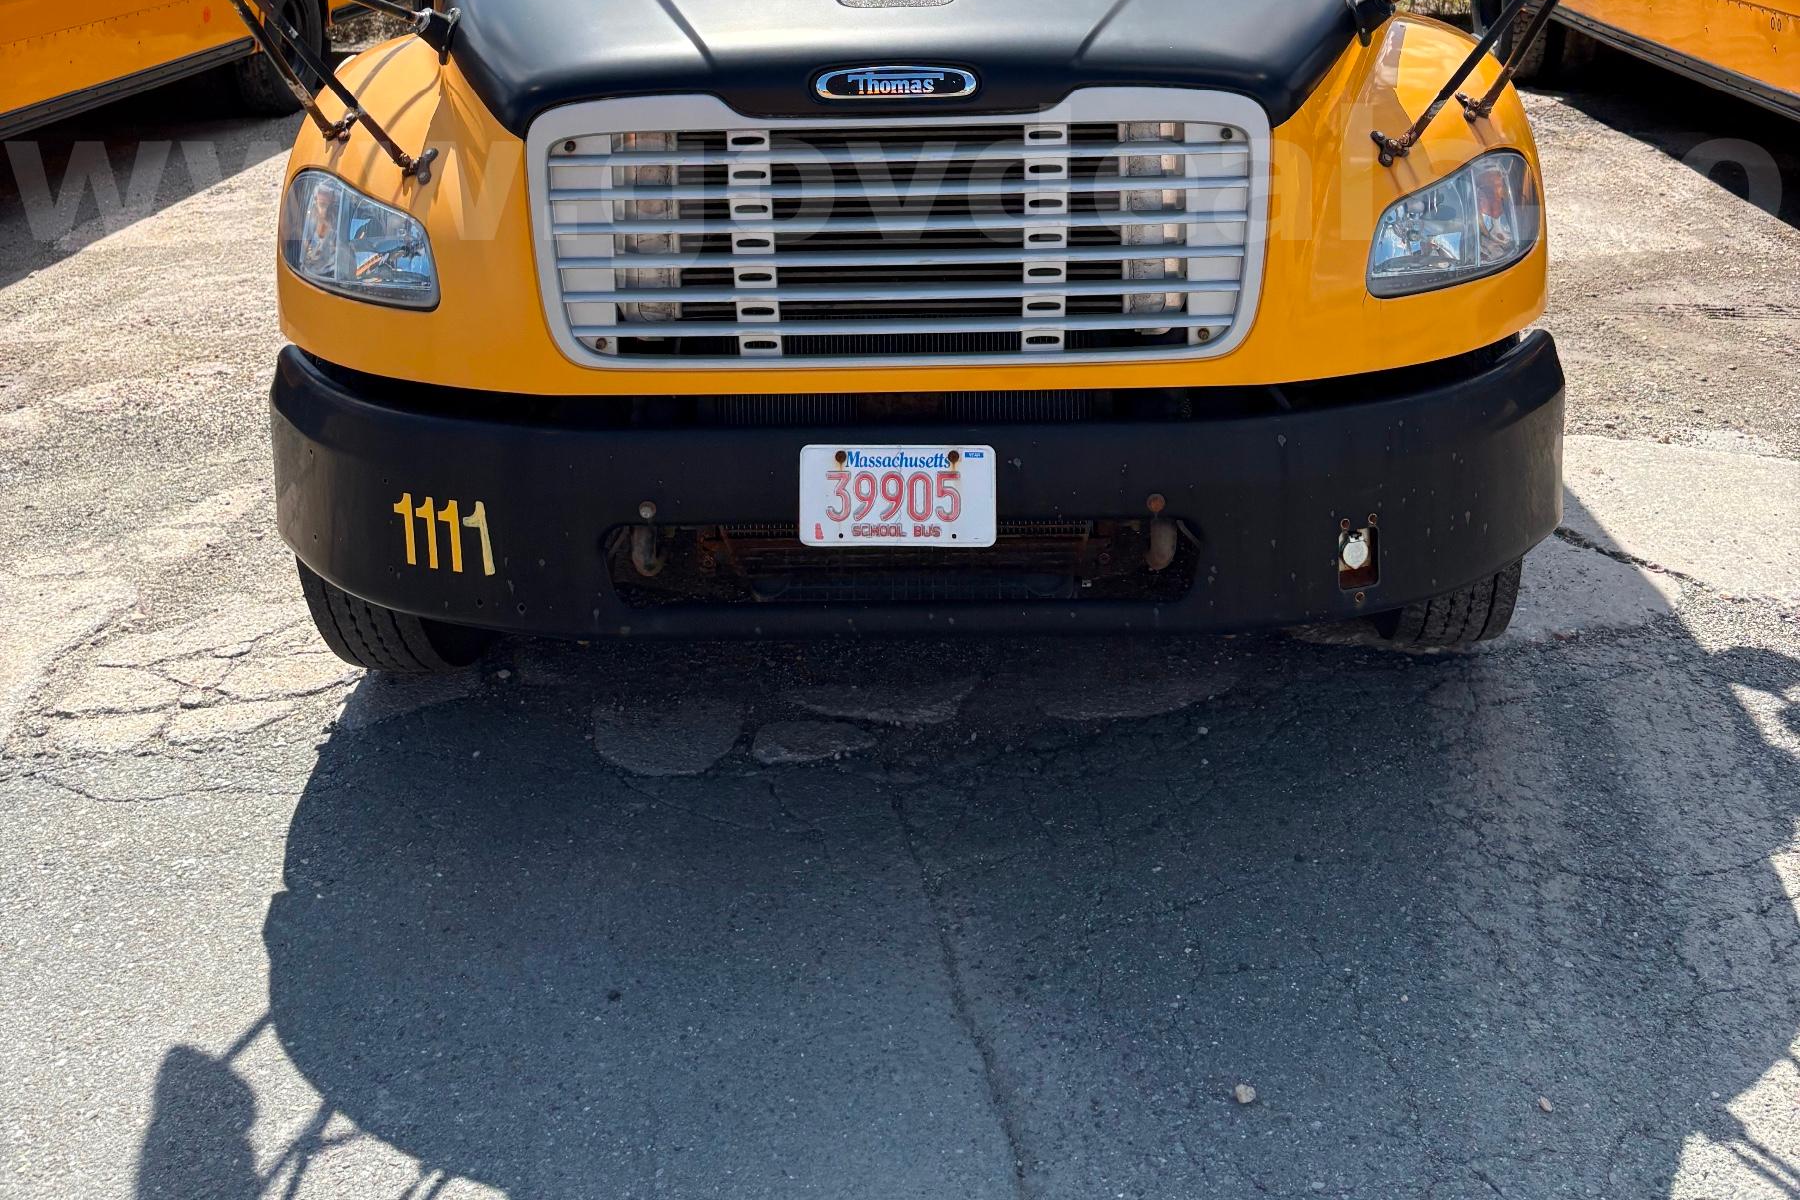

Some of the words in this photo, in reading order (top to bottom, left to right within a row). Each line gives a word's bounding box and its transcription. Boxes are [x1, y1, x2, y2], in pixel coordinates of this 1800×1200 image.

[847, 72, 945, 95] Thomas
[846, 450, 951, 469] Massachusetts
[825, 470, 962, 523] 39905
[393, 492, 496, 577] 1111
[851, 523, 907, 538] SCHOOL
[913, 523, 942, 538] BUS
